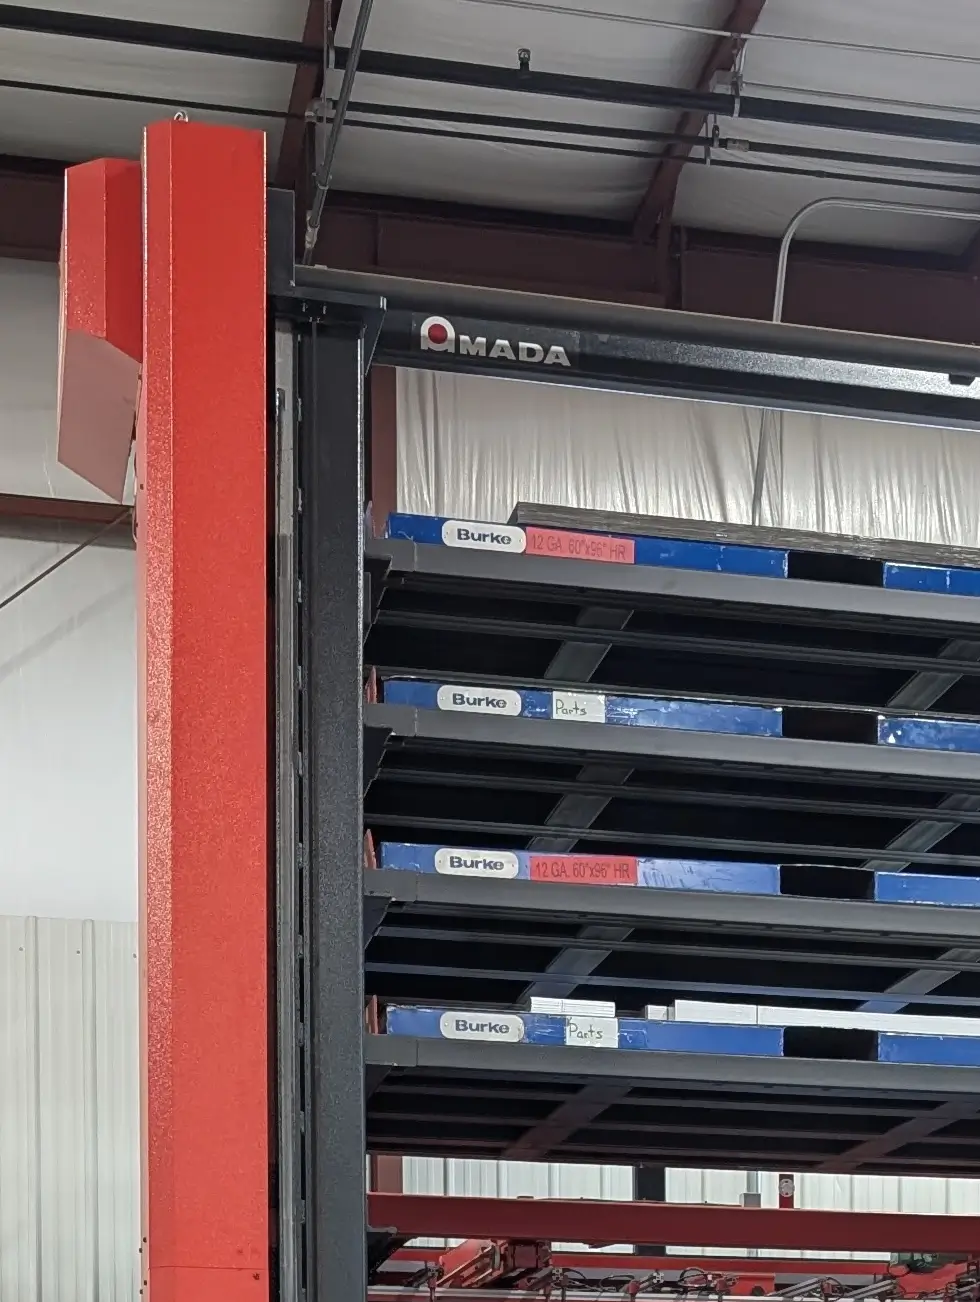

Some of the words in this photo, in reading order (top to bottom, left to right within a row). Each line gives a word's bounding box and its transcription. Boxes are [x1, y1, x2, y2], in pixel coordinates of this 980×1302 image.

[420, 315, 571, 367] AMADA
[456, 527, 512, 546] Burke
[532, 533, 544, 550] 12
[609, 544, 626, 560] HR
[452, 692, 507, 709] Burke
[555, 698, 588, 716] Parts
[449, 855, 505, 872] Burke
[535, 861, 549, 878] 12
[613, 863, 631, 879] HR
[455, 1018, 510, 1034] Burke
[567, 1022, 603, 1040] Parts
